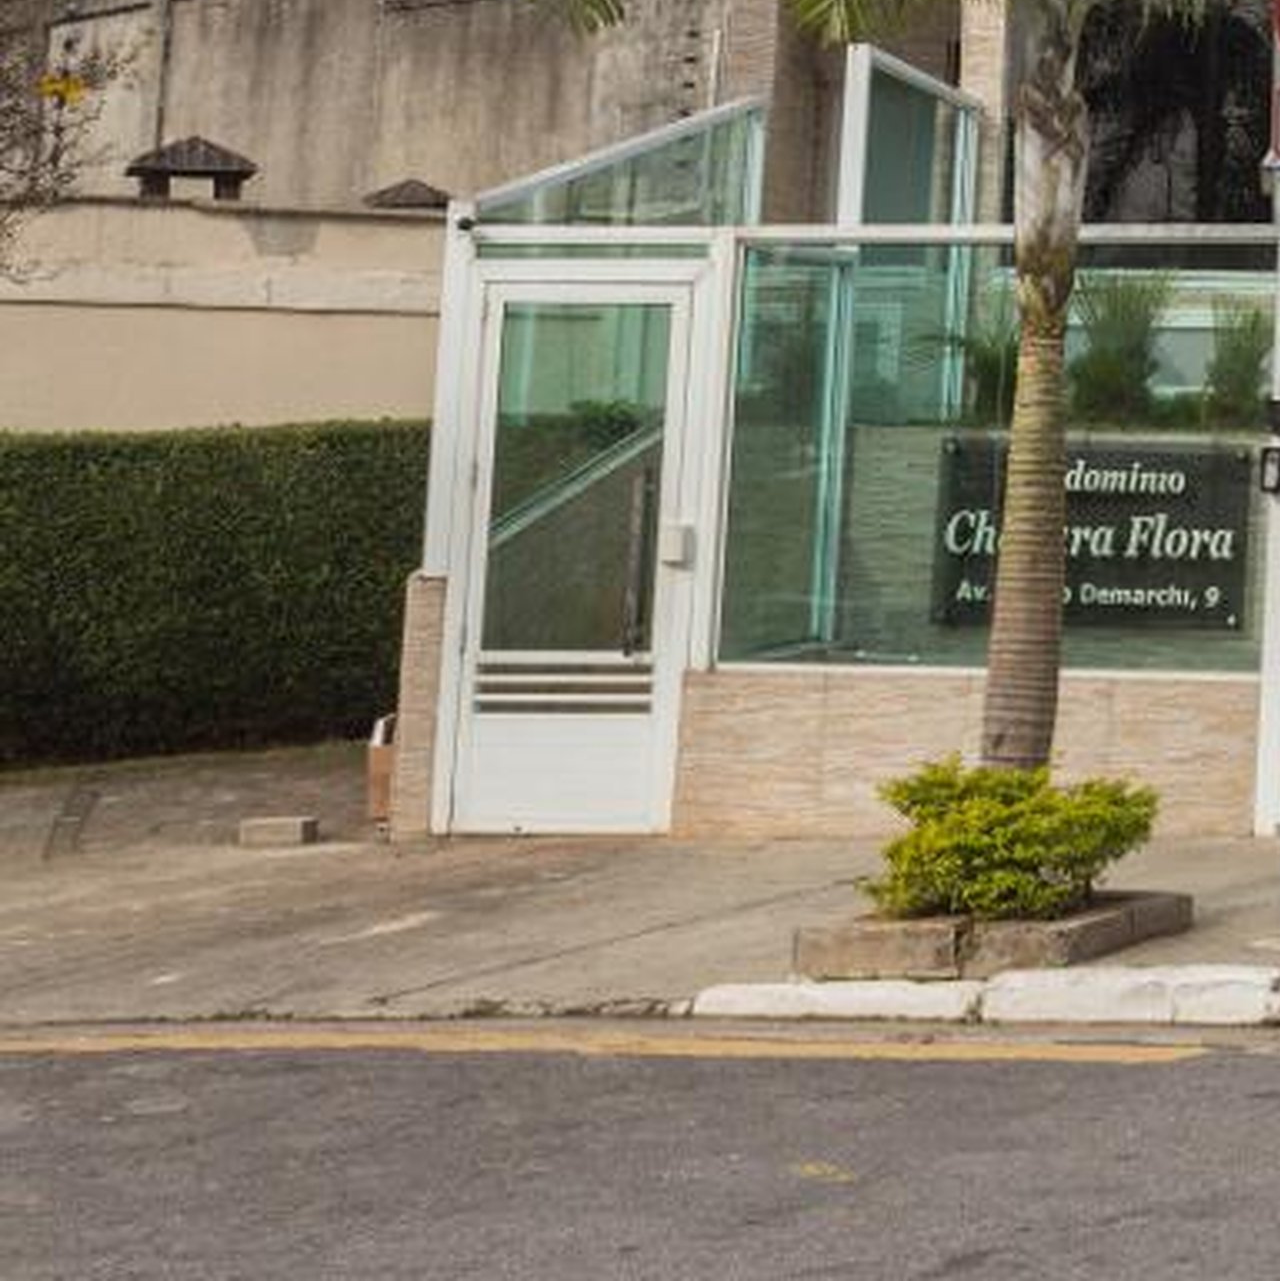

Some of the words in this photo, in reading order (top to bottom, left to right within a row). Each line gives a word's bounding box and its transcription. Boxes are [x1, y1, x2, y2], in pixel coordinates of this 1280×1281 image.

[945, 509, 1115, 558] Chra
[1123, 513, 1236, 560] Flora
[1204, 585, 1221, 608] 9
